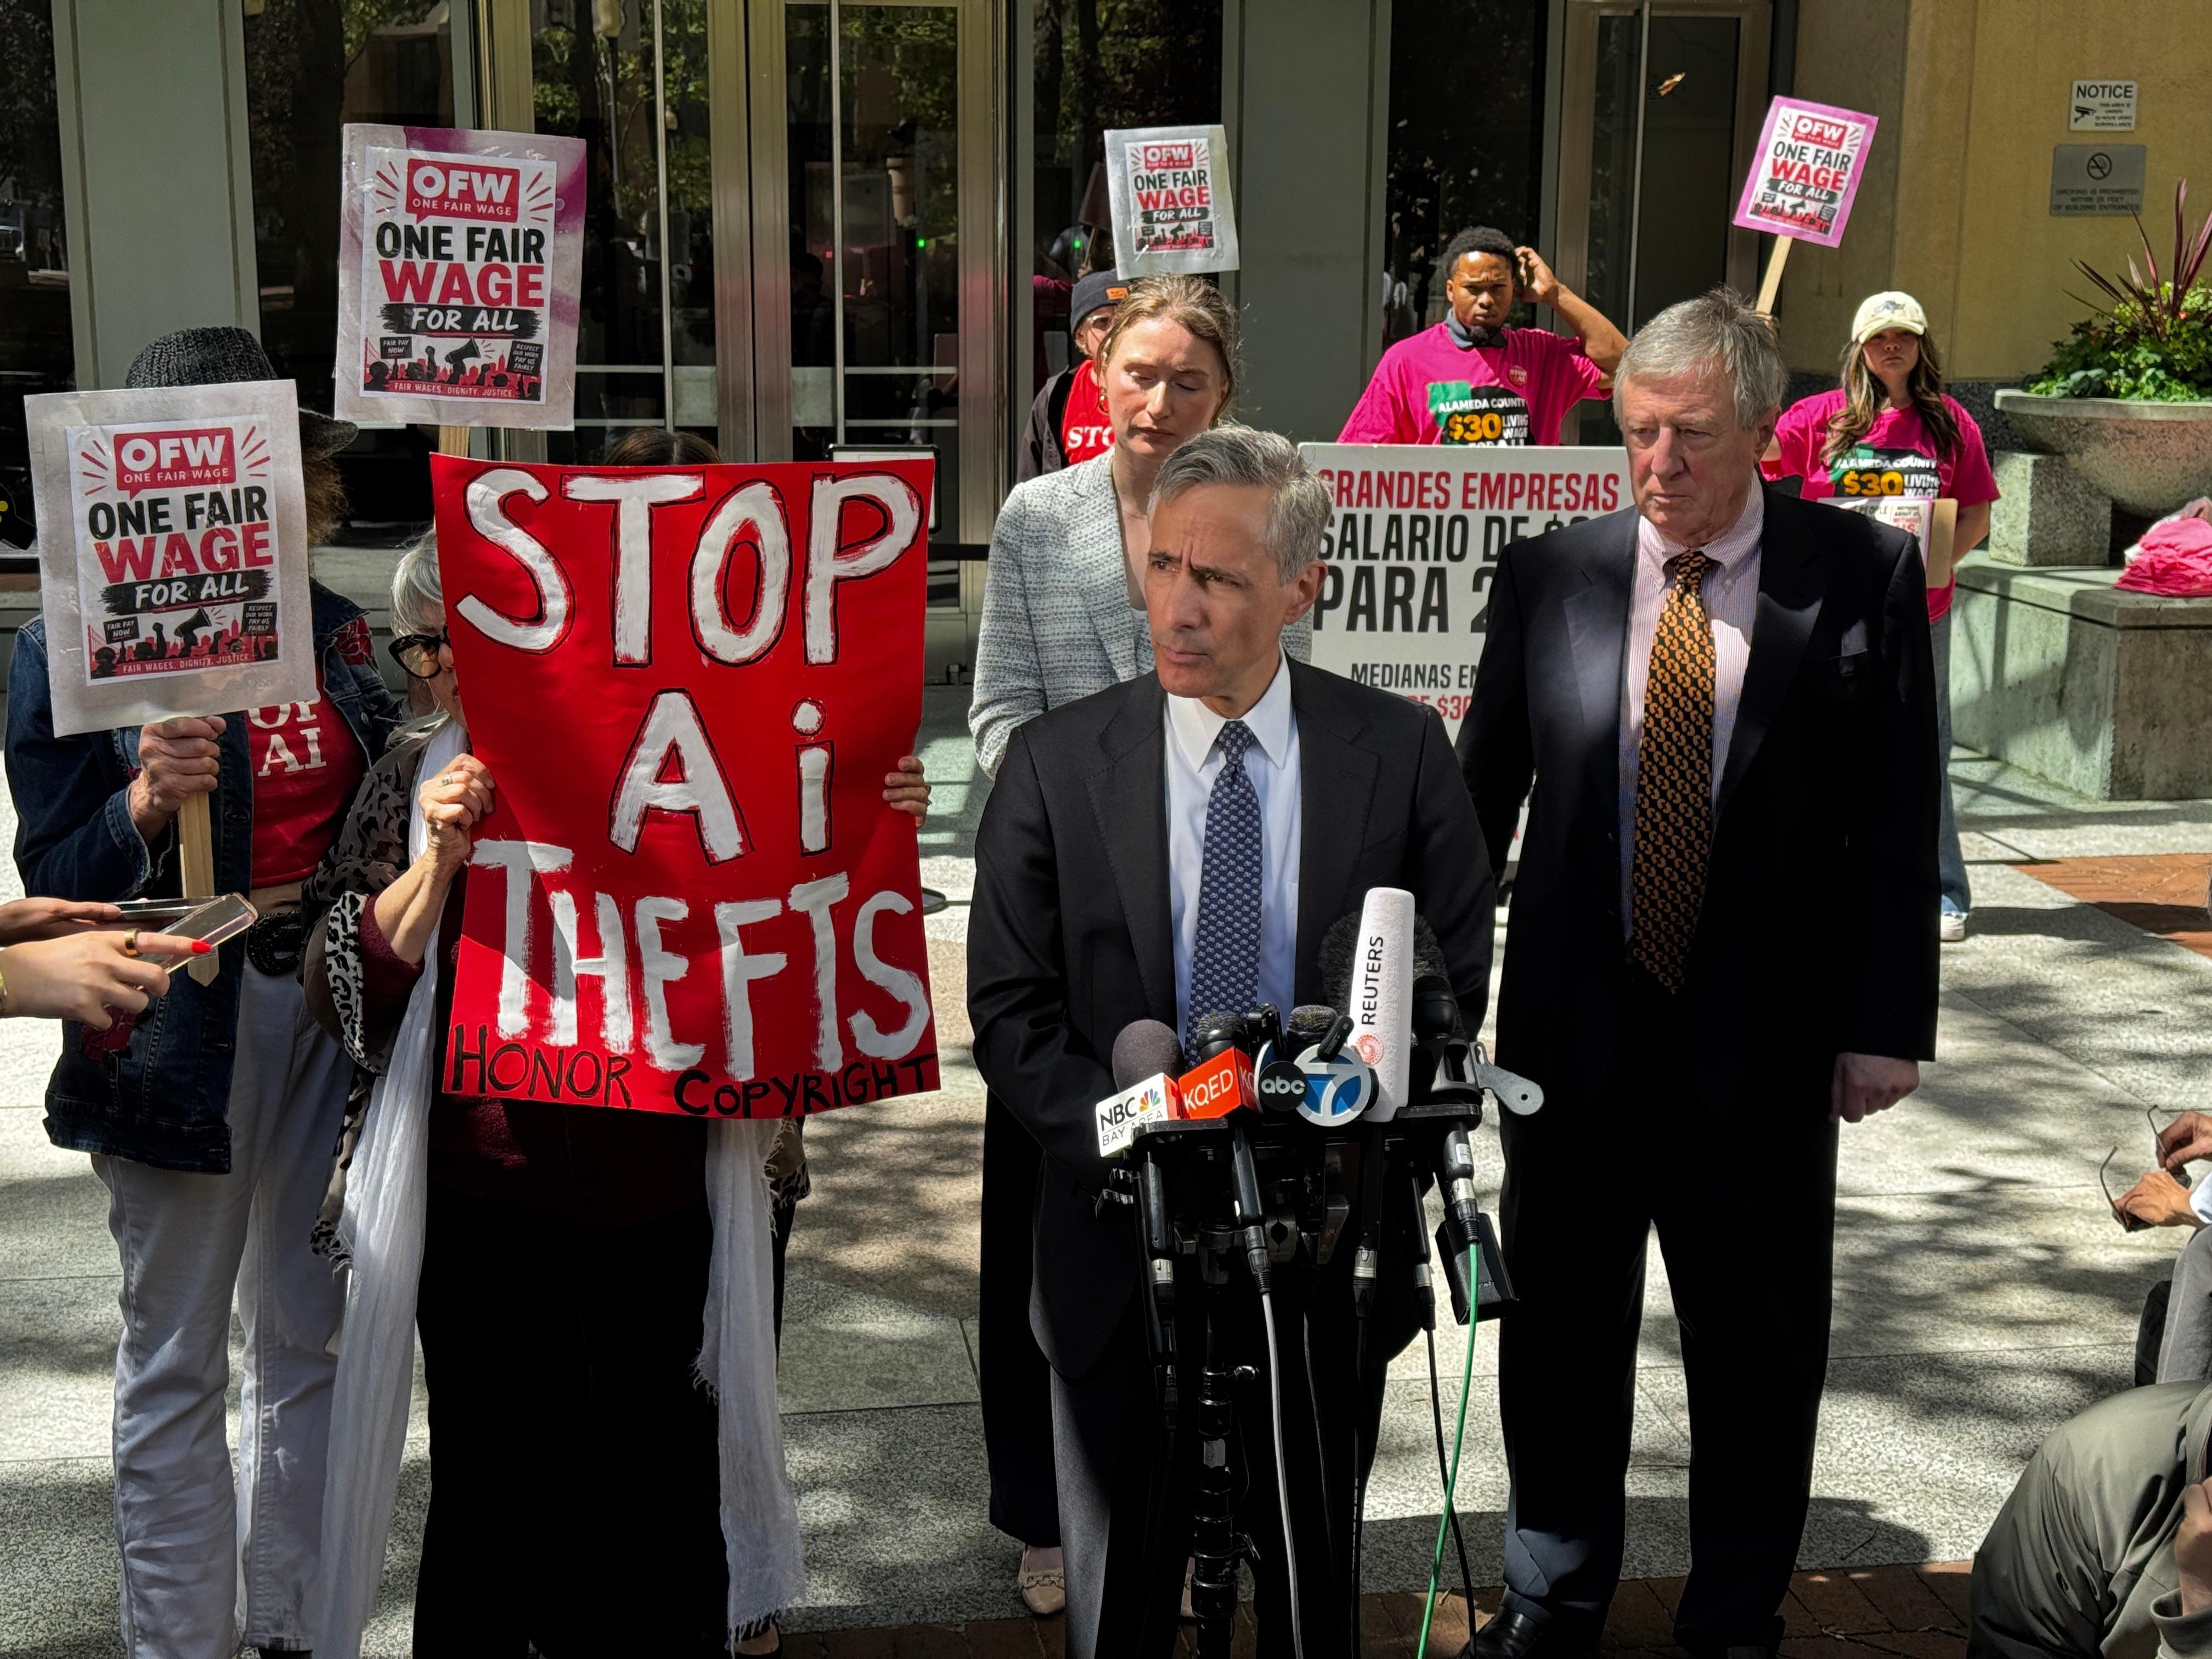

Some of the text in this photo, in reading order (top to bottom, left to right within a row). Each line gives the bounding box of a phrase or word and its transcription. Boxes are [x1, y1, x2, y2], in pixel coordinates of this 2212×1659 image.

[2076, 84, 2134, 99] NOTICE
[1797, 118, 1843, 140] OFW
[1147, 146, 1189, 162] OFW
[1774, 141, 1851, 171] ONE FAIR
[413, 166, 512, 203] OFW
[1134, 170, 1207, 191] ONE FAIR
[1771, 158, 1847, 191] WAGE
[1136, 186, 1211, 210] WAGE
[1778, 183, 1829, 201] FOR ALL
[413, 198, 511, 216] ONE FAIR WAGE
[1153, 208, 1201, 221] FOR ALL
[376, 222, 545, 264] ONE FAIR
[379, 260, 544, 307] WAGE
[411, 307, 519, 331] FOR ALL
[394, 382, 411, 391] FAIR
[1438, 398, 1526, 413] ALAMEDA COUNTY
[1449, 413, 1502, 441] $30
[1502, 414, 1528, 427] LIVING
[1503, 427, 1528, 438] WAGE
[121, 435, 225, 472] OFW
[123, 467, 229, 483] ONE FAIR WAGE
[1843, 470, 1903, 496] $30
[1319, 470, 1620, 512] GRANDES EMPRESAS
[89, 486, 269, 540] ONE FAIR
[1318, 512, 1469, 563] SALARIO
[93, 523, 273, 584] WAGE
[454, 466, 924, 668] STOP
[136, 573, 249, 608] FOR ALL
[1313, 565, 1449, 633] PARA
[107, 620, 135, 631] FAIR PAY
[113, 628, 131, 636] NOW
[123, 664, 142, 674] FAIR
[1351, 663, 1452, 689] MEDIANAS
[258, 727, 326, 777] AI
[471, 839, 930, 1082] THEFTS
[1362, 936, 1384, 1025] REUTERS
[451, 1023, 938, 1118] HONOR COPYRIGHT
[1184, 1069, 1233, 1110] KQED
[1261, 1075, 1306, 1095] abc
[1100, 1096, 1137, 1132] NBC
[1102, 1128, 1125, 1147] BAY
